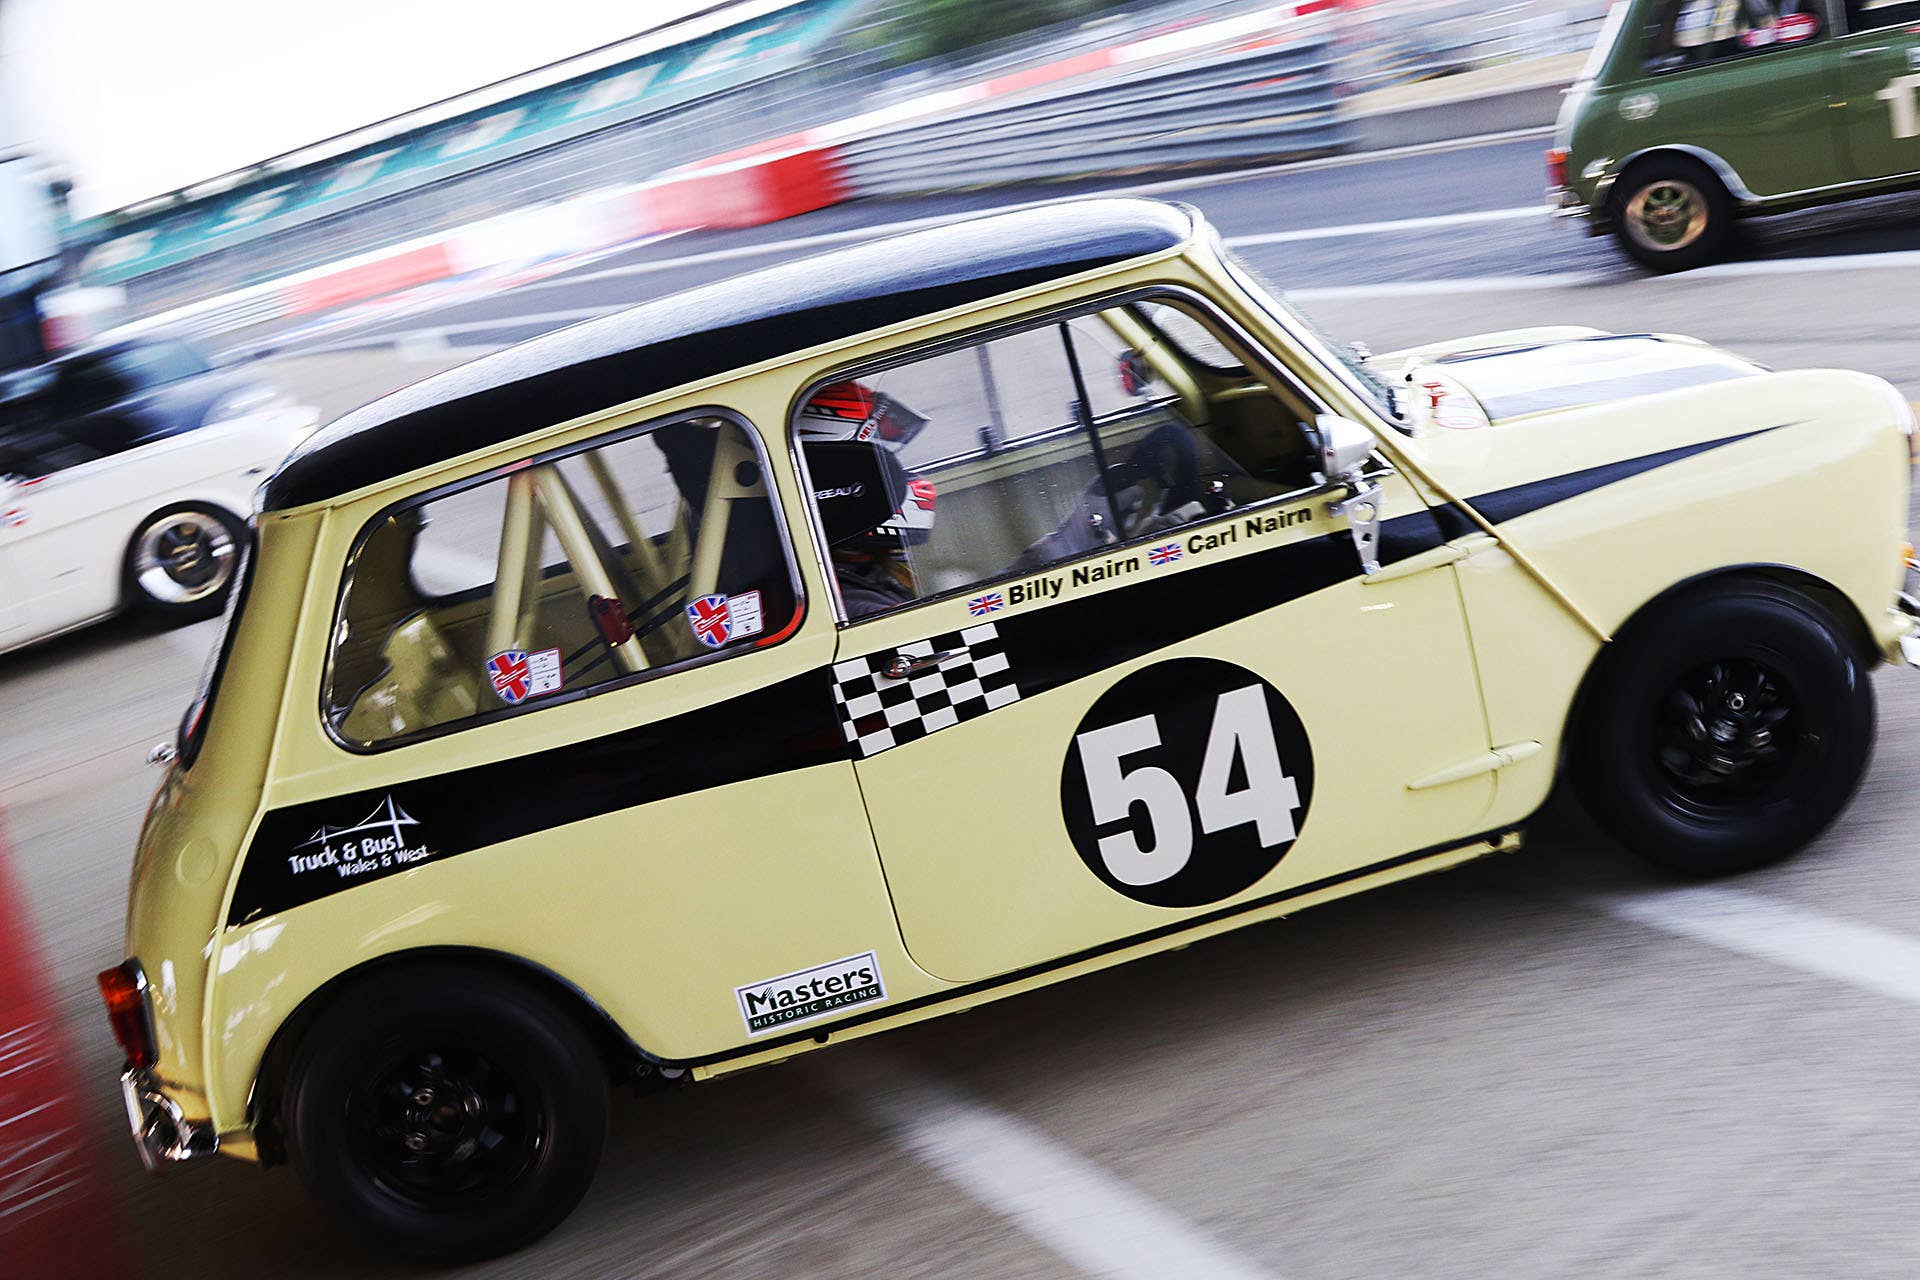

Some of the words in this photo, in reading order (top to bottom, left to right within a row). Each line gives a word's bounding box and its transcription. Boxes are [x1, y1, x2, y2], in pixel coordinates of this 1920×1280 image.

[1188, 529, 1238, 554] Carl
[1246, 506, 1312, 538] Nairn
[1008, 576, 1063, 606] Billy
[1072, 555, 1140, 588] Nairn
[1076, 683, 1301, 886] 54
[288, 845, 340, 875] Truck
[342, 842, 358, 861] &
[360, 835, 397, 857] Bus
[336, 857, 379, 878] Wales
[381, 853, 393, 868] &
[394, 844, 429, 864] West
[745, 967, 874, 1016] Masters
[753, 1003, 819, 1028] HISTORIC
[825, 986, 878, 1008] RACING
